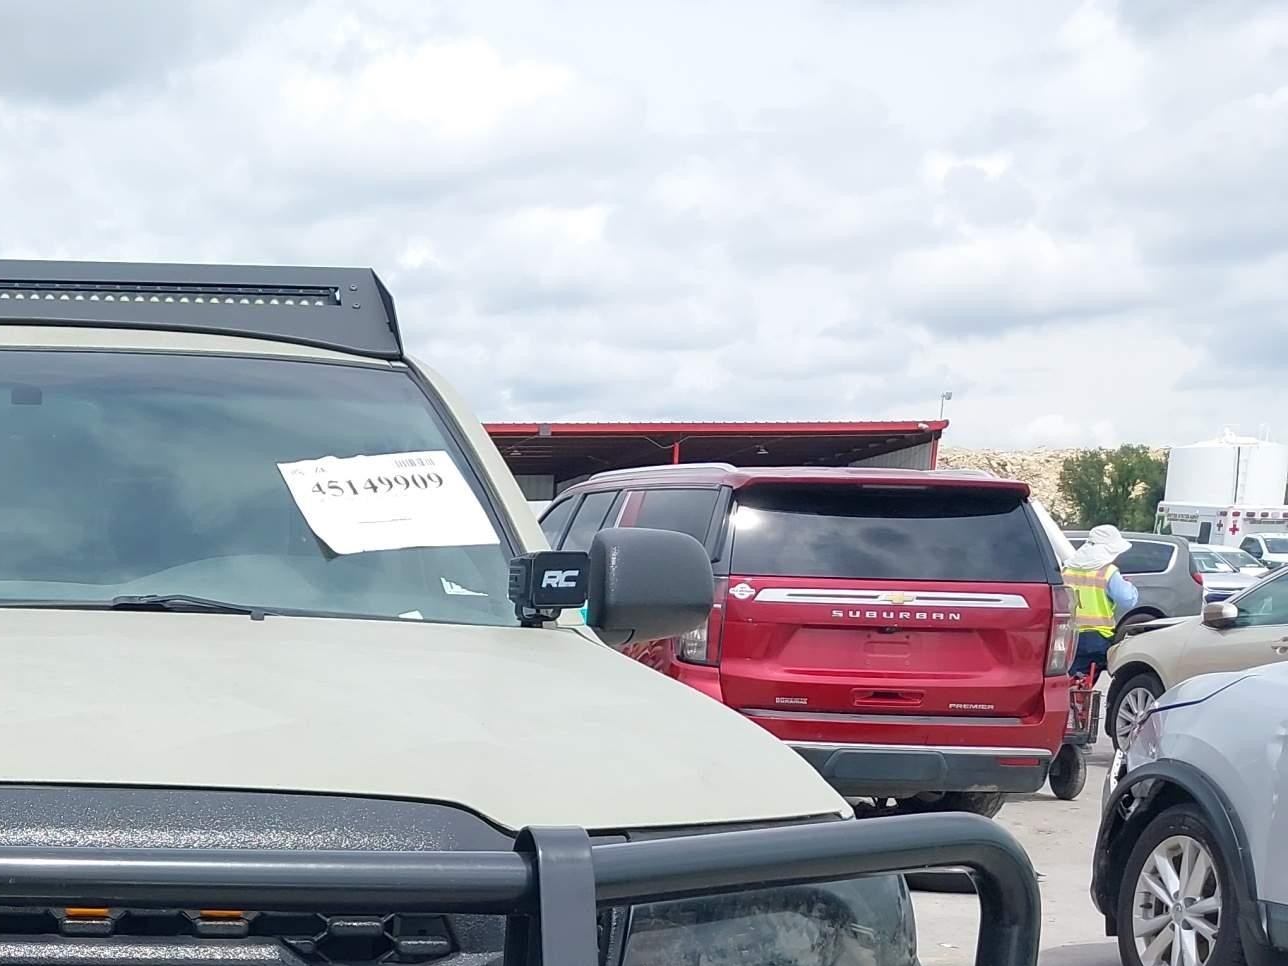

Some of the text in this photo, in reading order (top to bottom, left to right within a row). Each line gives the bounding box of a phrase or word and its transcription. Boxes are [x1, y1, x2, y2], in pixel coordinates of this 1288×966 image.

[311, 472, 444, 498] 45149909
[541, 569, 580, 588] RC
[831, 609, 961, 621] SUBURBAN
